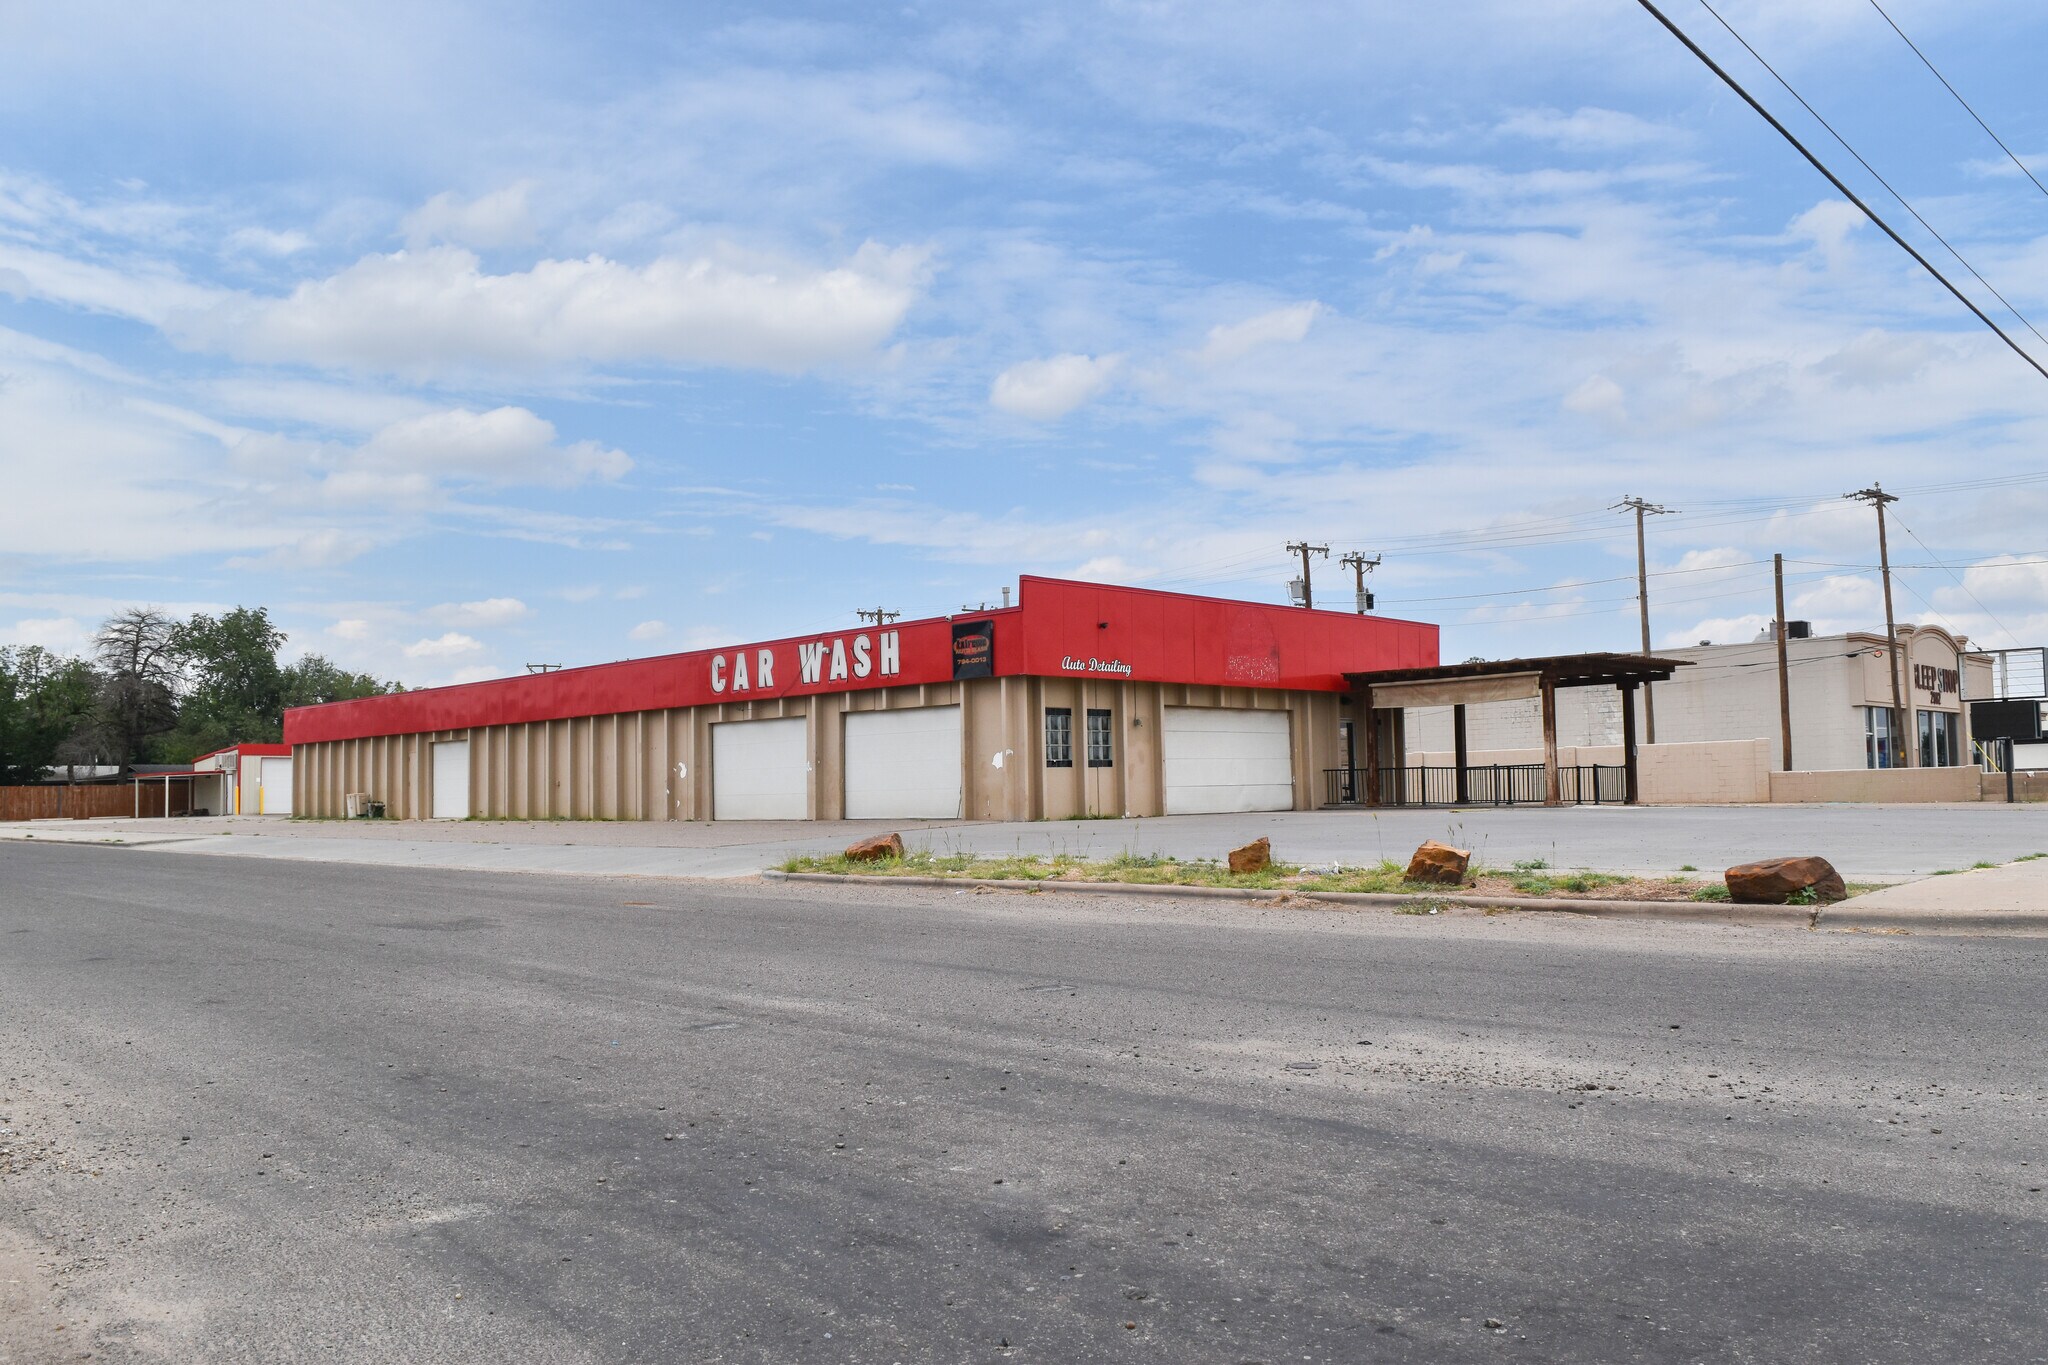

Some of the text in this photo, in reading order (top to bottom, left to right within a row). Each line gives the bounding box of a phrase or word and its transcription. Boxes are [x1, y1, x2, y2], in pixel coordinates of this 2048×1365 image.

[711, 630, 900, 693] CAR WASH
[1061, 656, 1132, 677] Auto Detailing
[1937, 667, 1958, 694] SHOP
